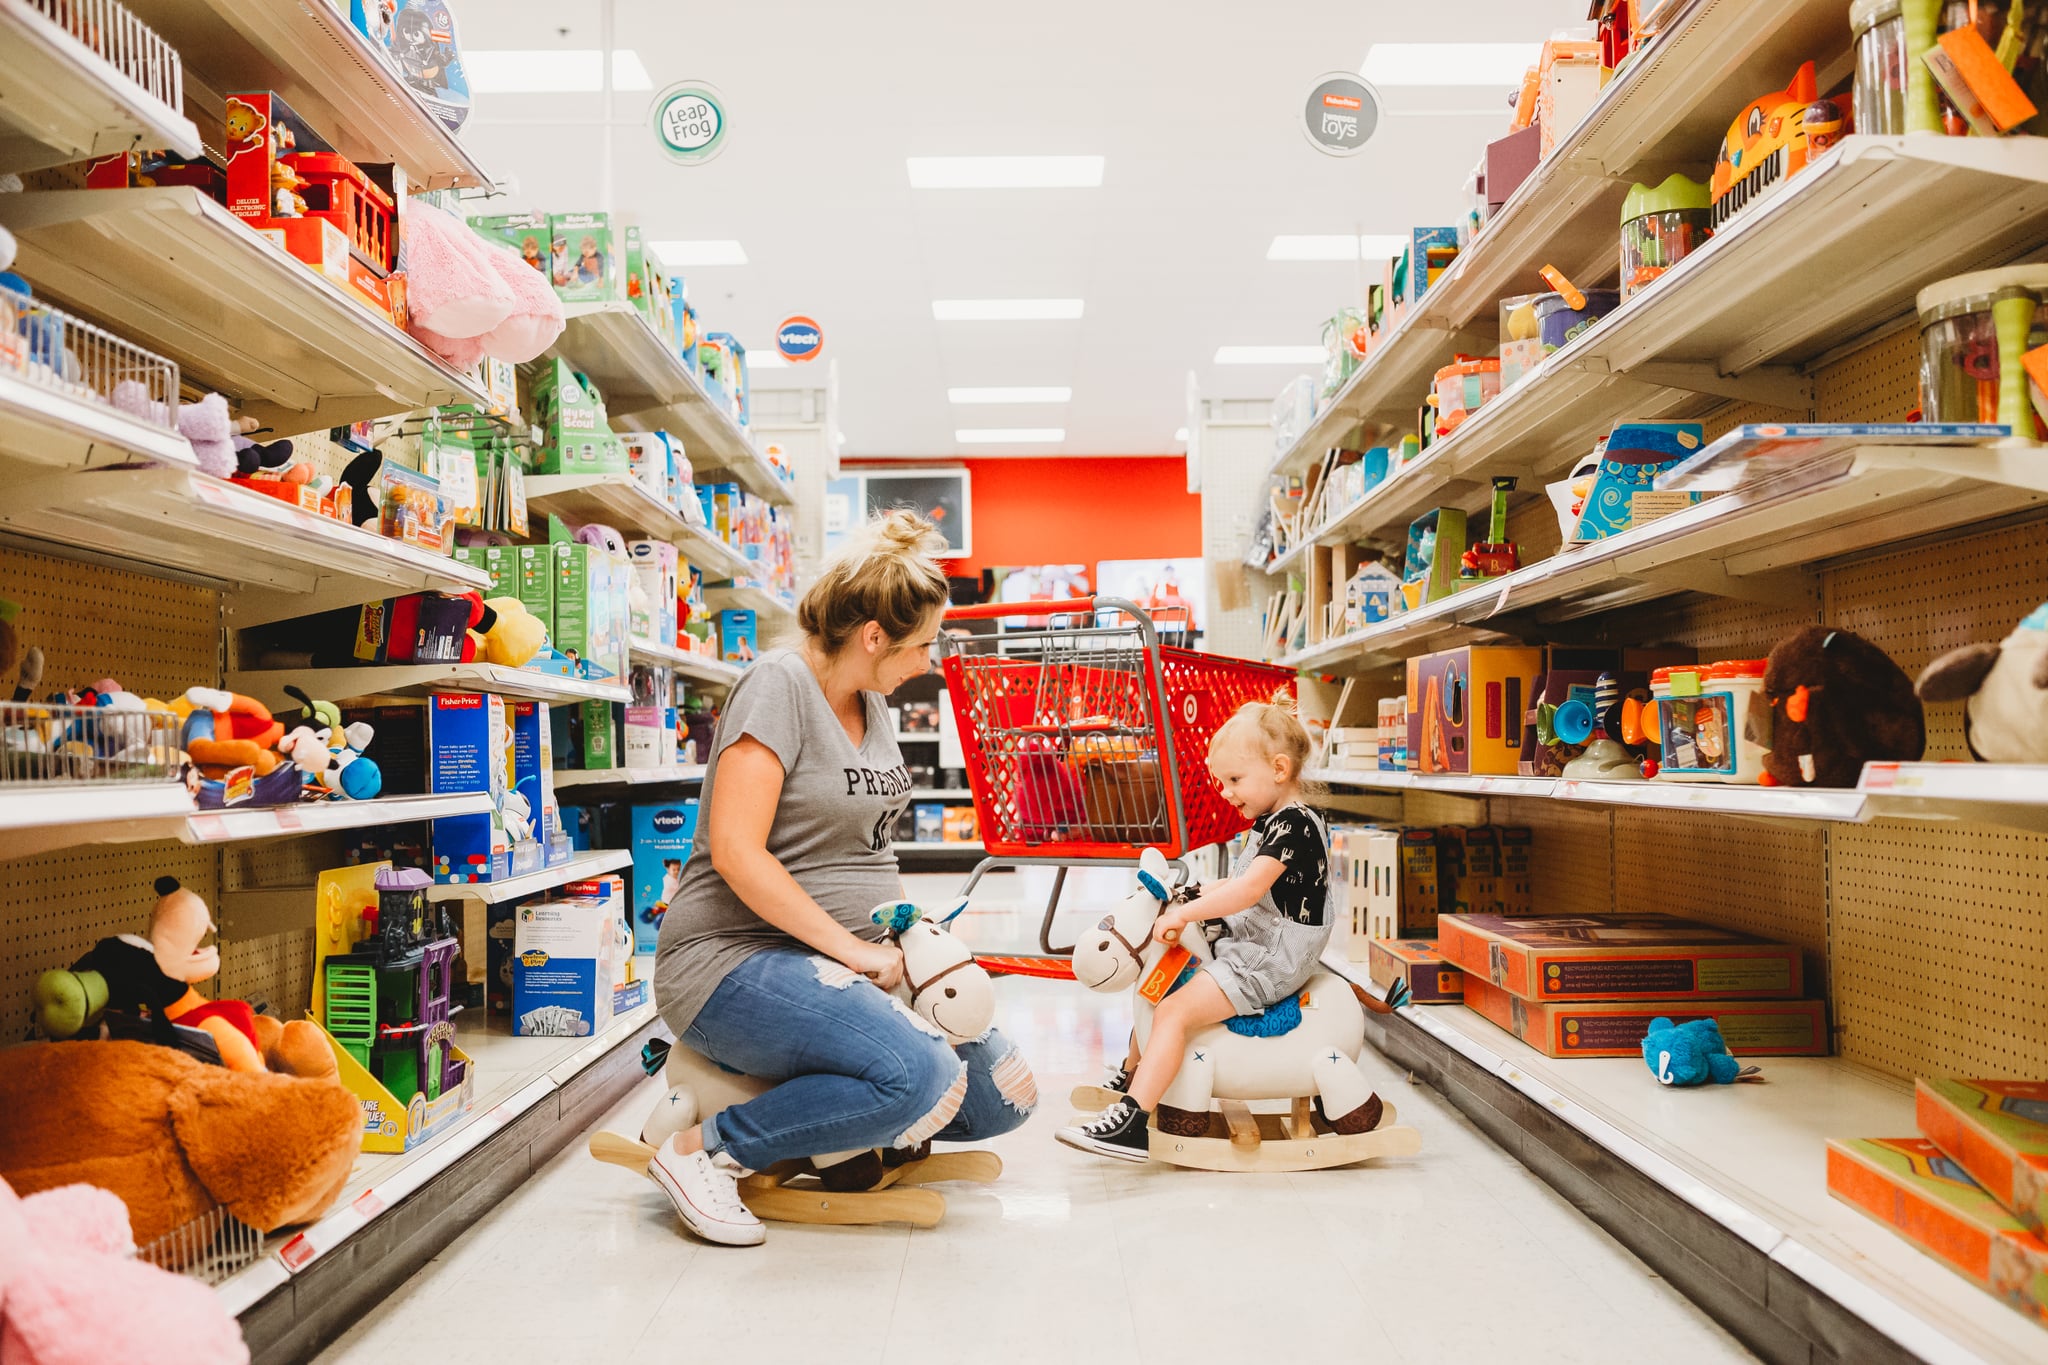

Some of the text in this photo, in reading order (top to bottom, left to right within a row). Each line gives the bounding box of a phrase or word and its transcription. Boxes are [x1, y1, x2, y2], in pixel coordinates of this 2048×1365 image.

[669, 104, 708, 125] Leap
[672, 120, 711, 141] Frog
[1322, 112, 1358, 140] toys
[779, 333, 818, 345] vtech
[562, 407, 595, 420] My Pal
[563, 418, 595, 430] Scout
[440, 696, 479, 706] Fisher-Price
[843, 763, 913, 797] PREGNA
[654, 815, 684, 825] vtech
[566, 883, 598, 893] Fisher-Price
[525, 910, 560, 918] Learning
[1141, 968, 1166, 998] B.
